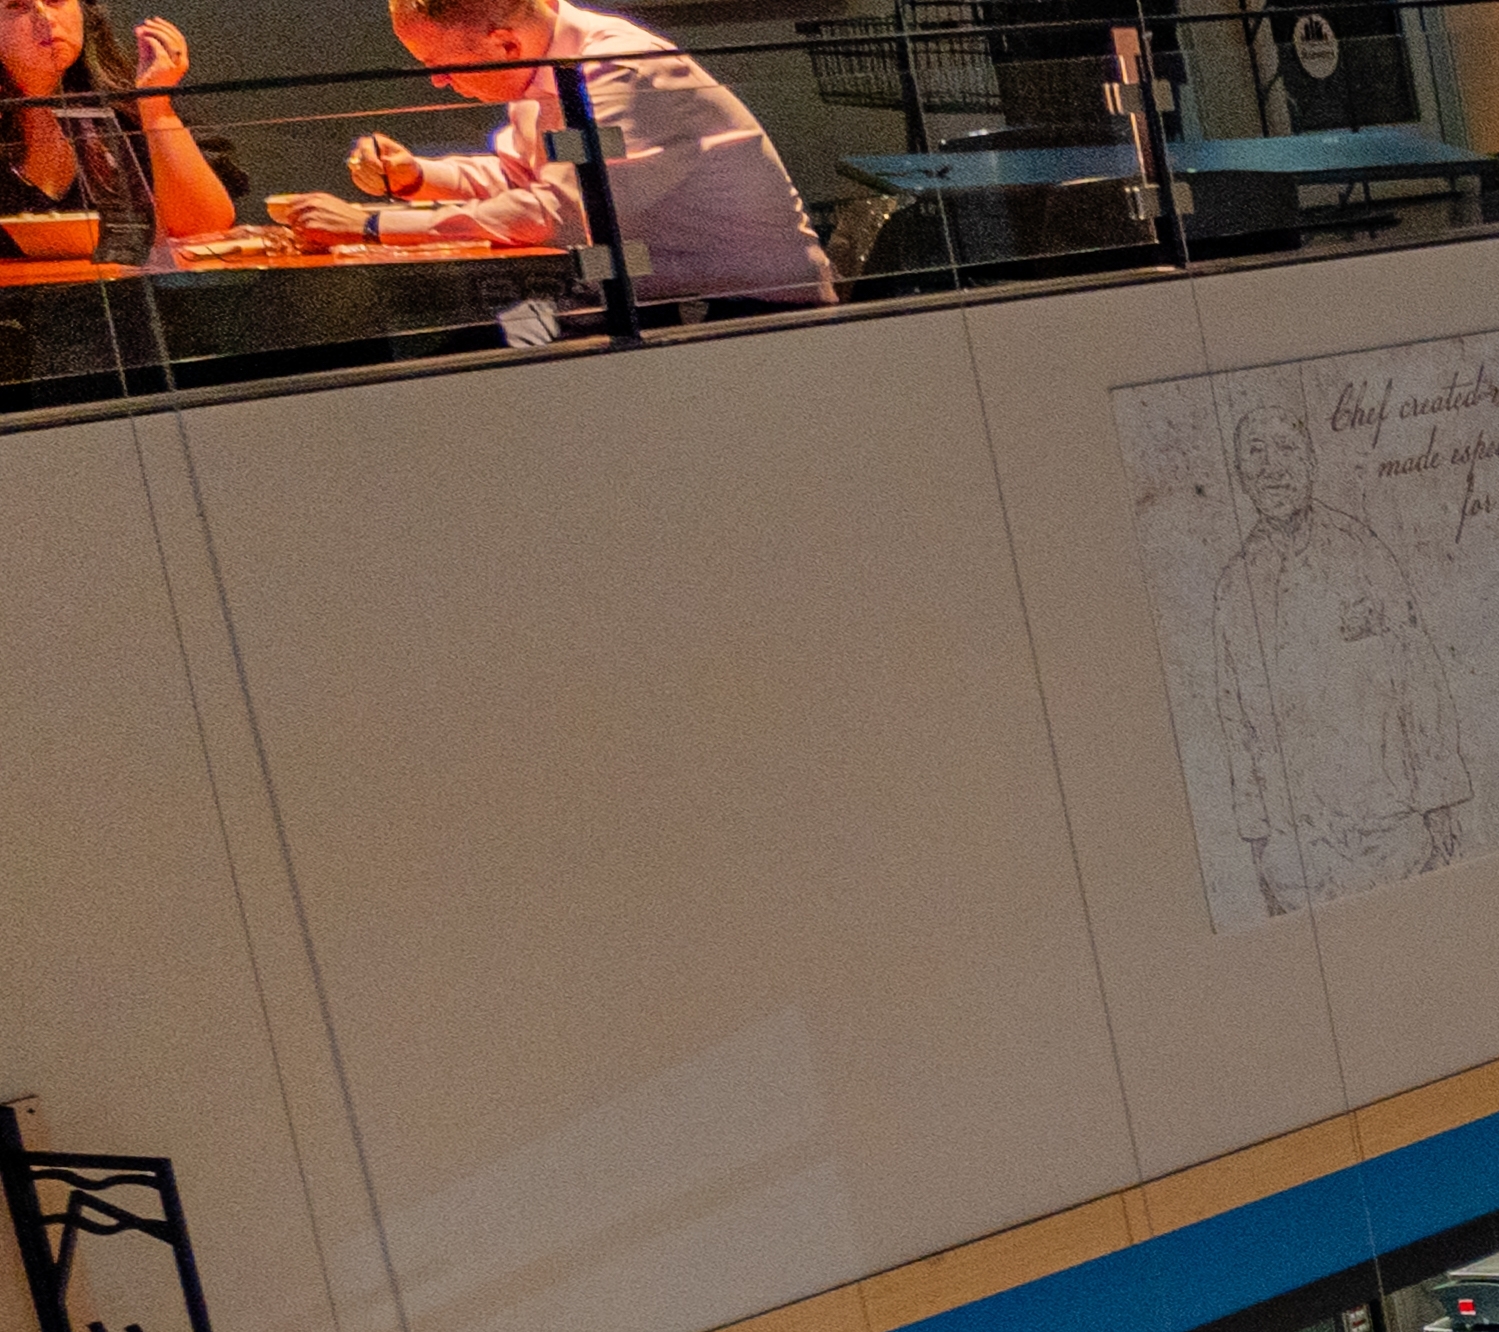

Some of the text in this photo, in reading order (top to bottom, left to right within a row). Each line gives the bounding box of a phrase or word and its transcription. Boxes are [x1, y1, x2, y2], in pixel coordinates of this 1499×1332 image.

[1330, 378, 1393, 449] Chef
[1400, 365, 1484, 419] created
[1378, 425, 1440, 478] made
[1455, 473, 1491, 544] for
